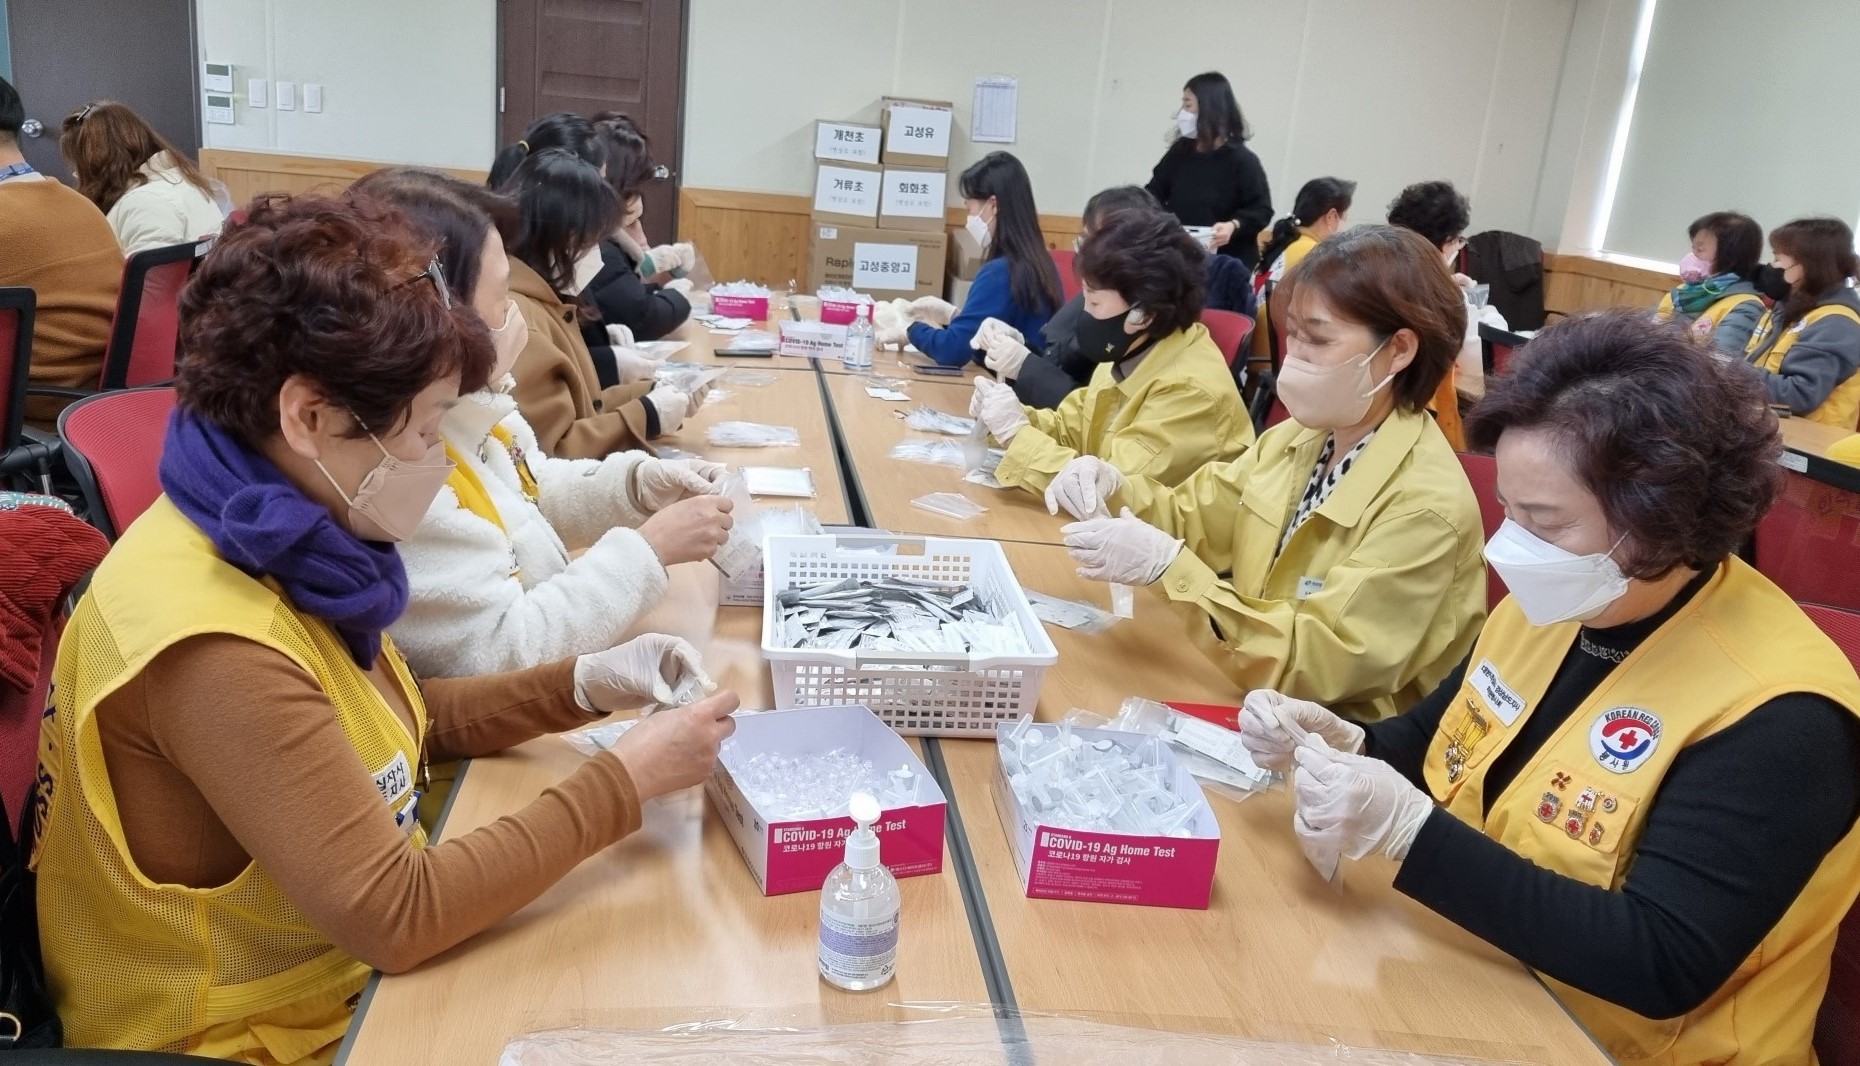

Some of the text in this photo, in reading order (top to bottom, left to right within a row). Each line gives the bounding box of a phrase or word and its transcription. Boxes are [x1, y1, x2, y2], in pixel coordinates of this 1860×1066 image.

[833, 129, 864, 142] 개천초
[904, 125, 935, 139] 고성유
[833, 179, 864, 192] 거류초
[859, 260, 911, 274] 고성중앙고
[1605, 709, 1639, 723] KOREAN
[783, 828, 835, 843] COVID-19
[836, 827, 851, 840] Ag
[885, 819, 907, 832] Test
[782, 843, 816, 853] 코로나19
[817, 841, 832, 850] 항원
[1048, 836, 1176, 858] COVID-19 Ag Home Test
[1047, 850, 1132, 866] 코로나19 항원 자가 검사
